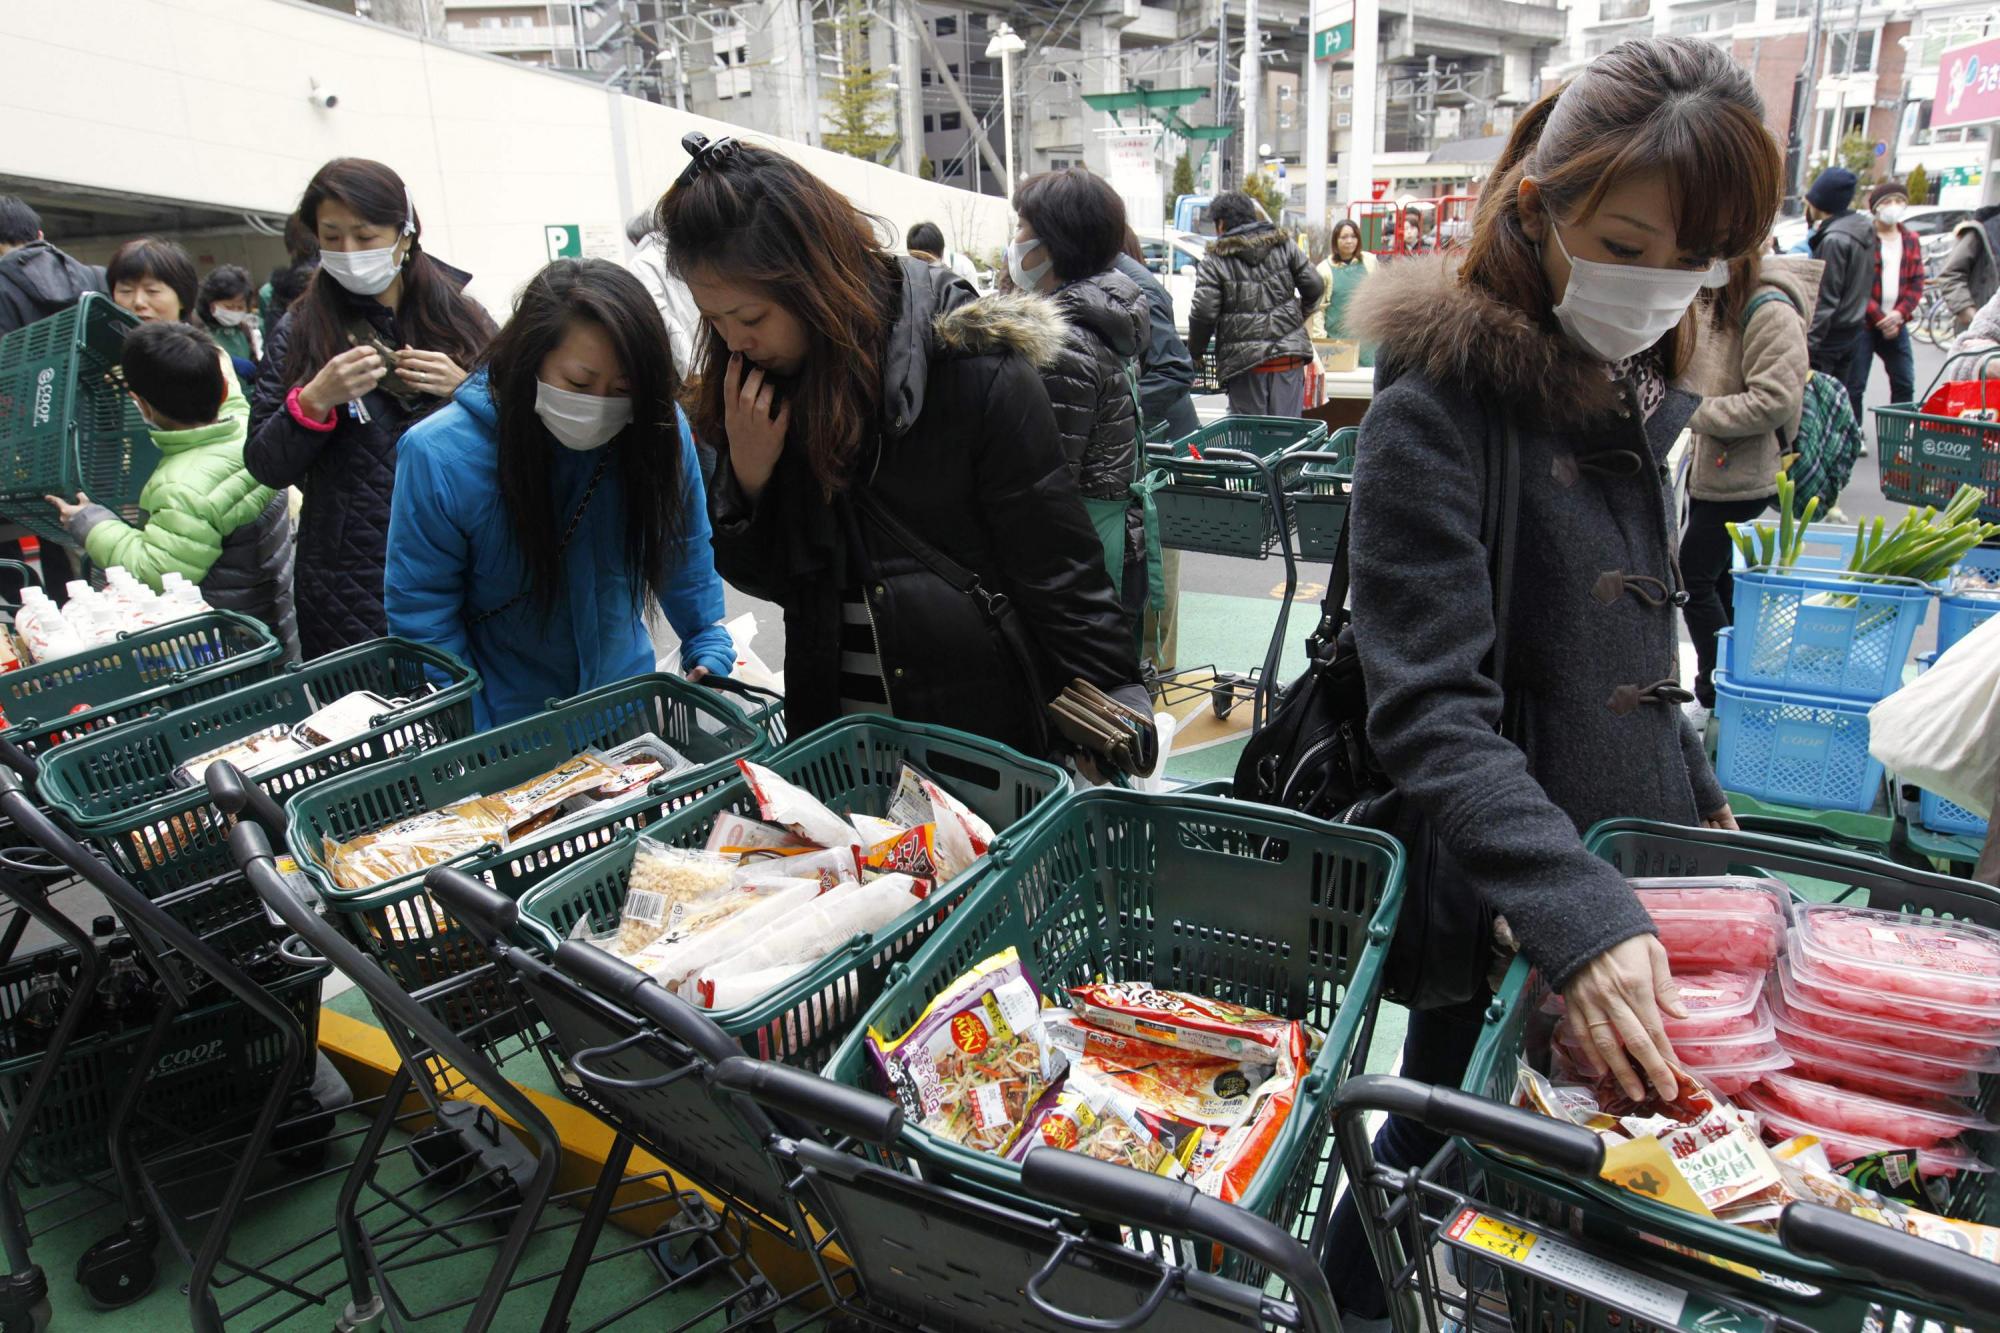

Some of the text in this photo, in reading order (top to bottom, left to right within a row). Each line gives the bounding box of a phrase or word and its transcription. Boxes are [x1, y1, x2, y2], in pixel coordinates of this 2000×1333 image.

[1325, 31, 1334, 54] P
[546, 226, 569, 260] P
[37, 384, 53, 423] COOP
[1936, 441, 1971, 456] COOP
[953, 1016, 982, 1053] New
[159, 1039, 224, 1069] COOP
[1679, 1140, 1744, 1172] 100%
